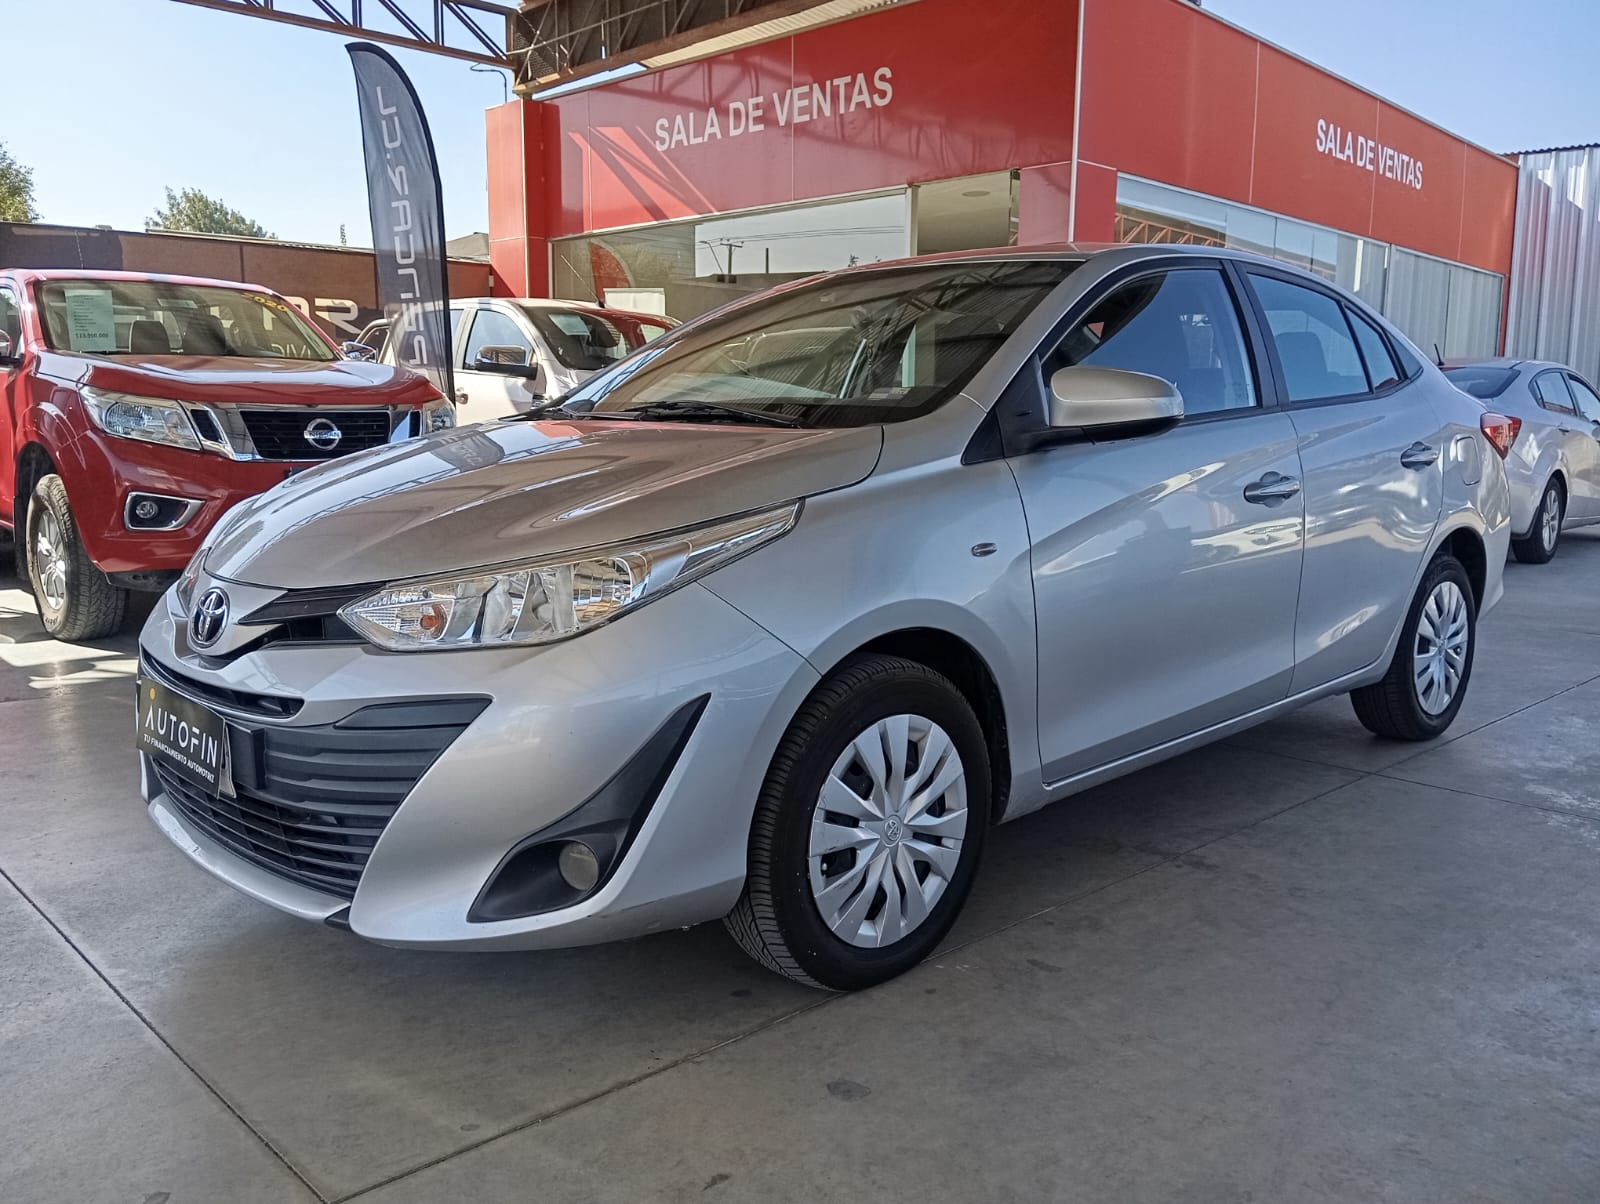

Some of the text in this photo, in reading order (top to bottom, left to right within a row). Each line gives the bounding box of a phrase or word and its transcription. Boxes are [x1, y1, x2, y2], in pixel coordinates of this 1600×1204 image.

[655, 67, 893, 152] SALA DE VENTAS
[1316, 118, 1423, 190] SALA DE VENTAS
[241, 292, 289, 312] 2020
[143, 733, 215, 783] TU FINANCIAMIENTO AUTOMOTRIZ
[145, 704, 218, 768] AUTOFIN
